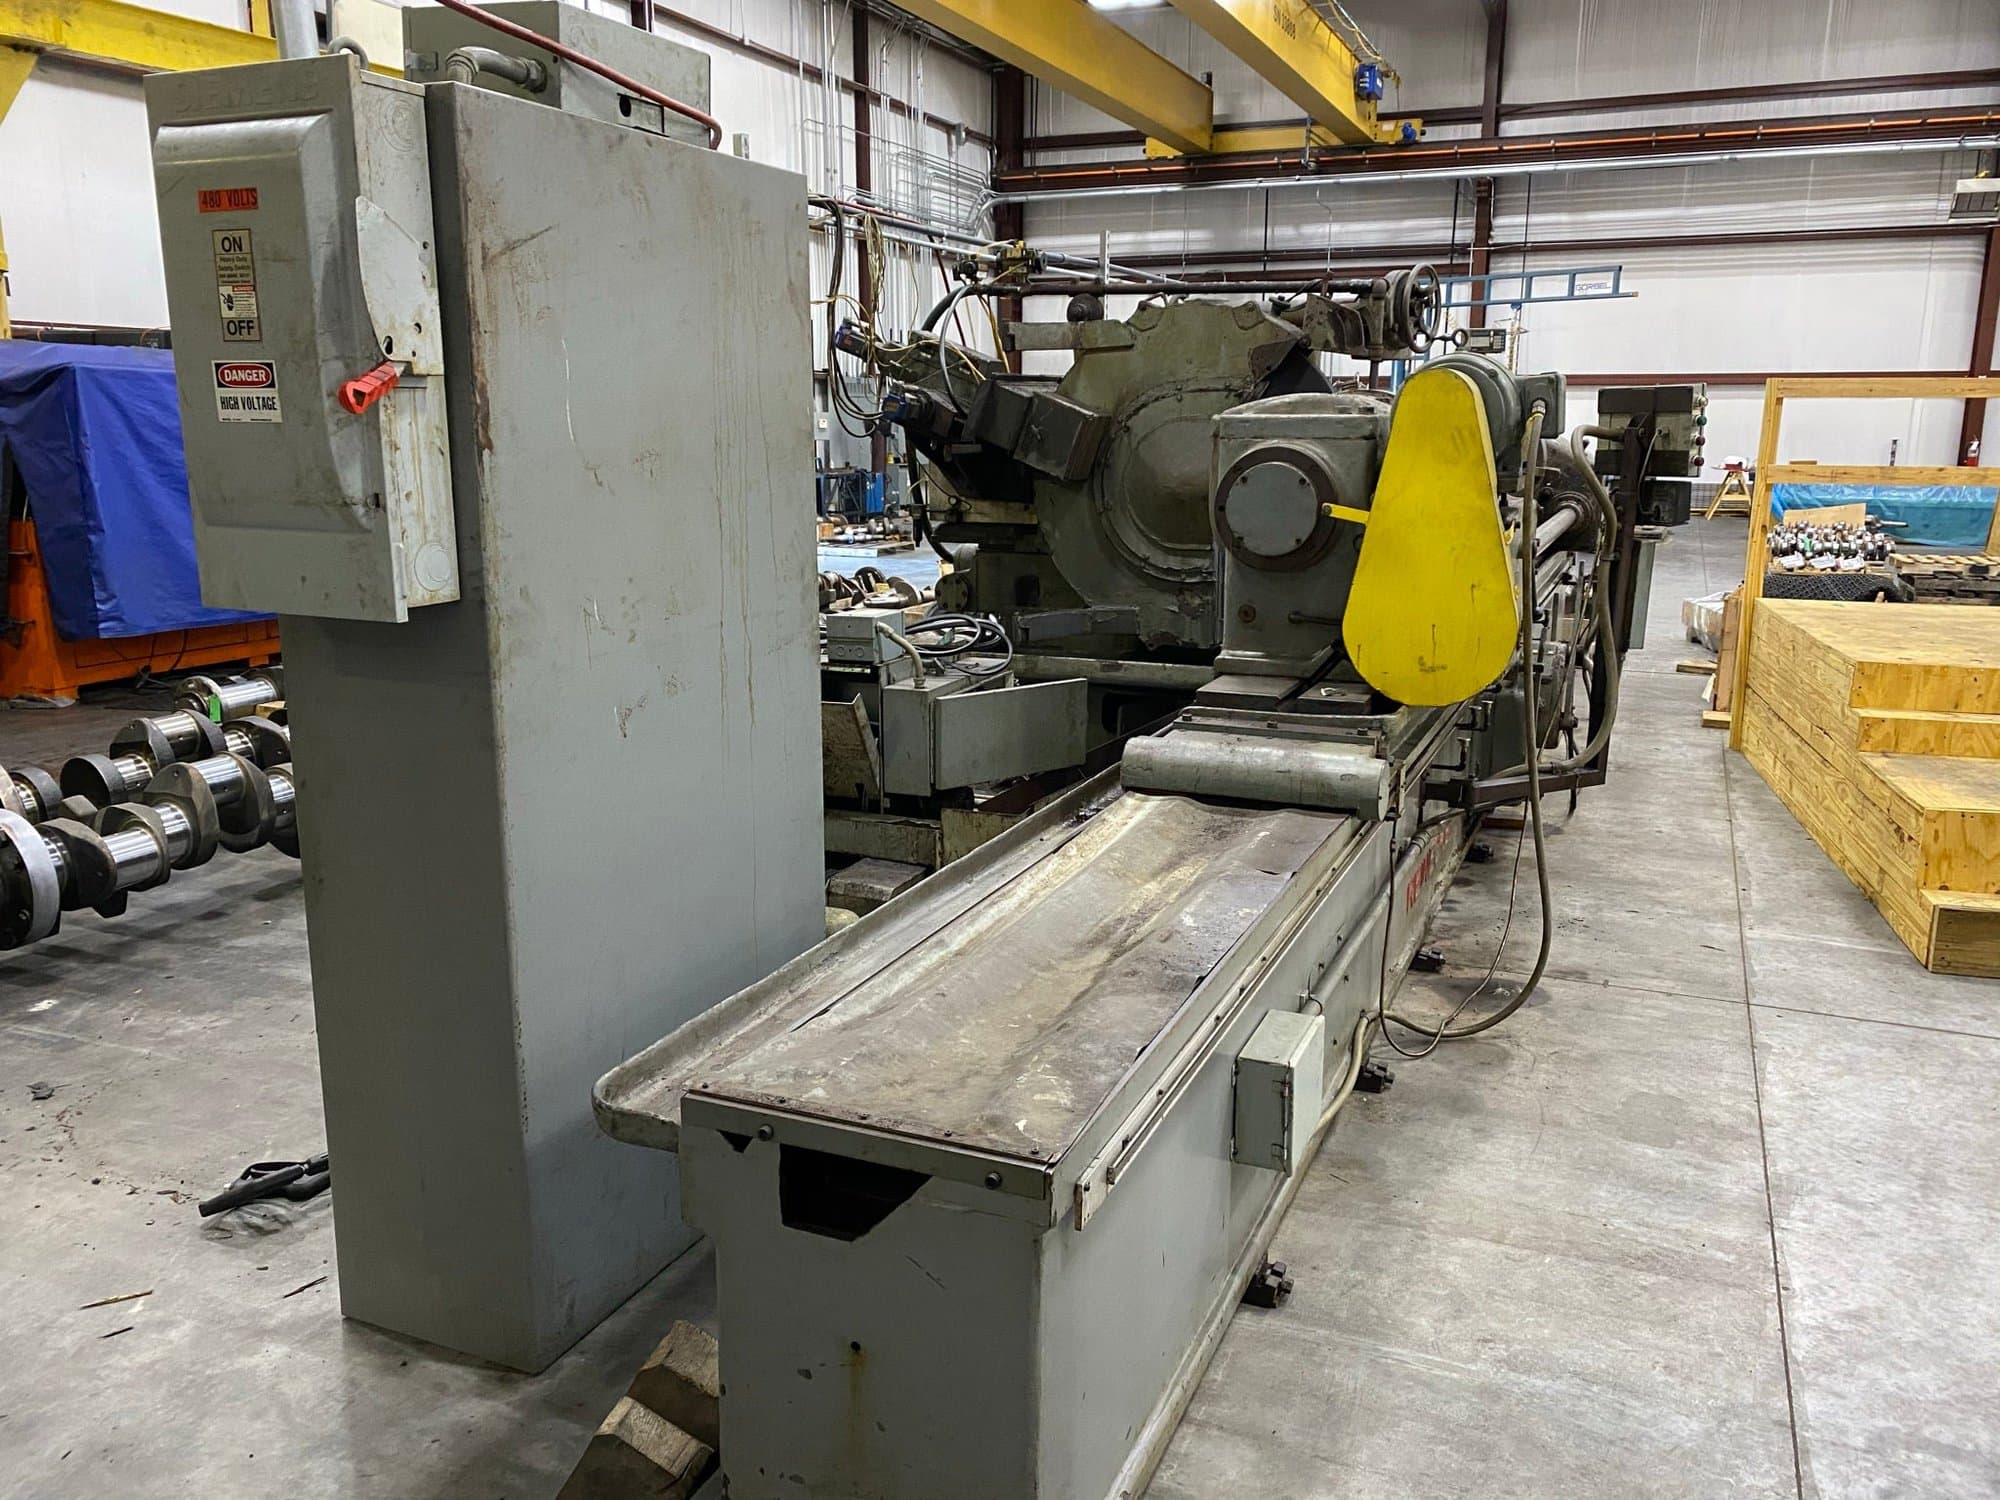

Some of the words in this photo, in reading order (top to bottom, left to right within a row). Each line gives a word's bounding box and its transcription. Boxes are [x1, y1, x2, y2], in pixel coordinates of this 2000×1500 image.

[202, 189, 220, 208] 480
[227, 188, 258, 207] VOLTS
[221, 236, 243, 252] ON
[226, 320, 255, 336] OFF
[223, 369, 267, 382] DANGER
[220, 396, 240, 410] HIGH
[240, 396, 278, 410] VOLTAGE
